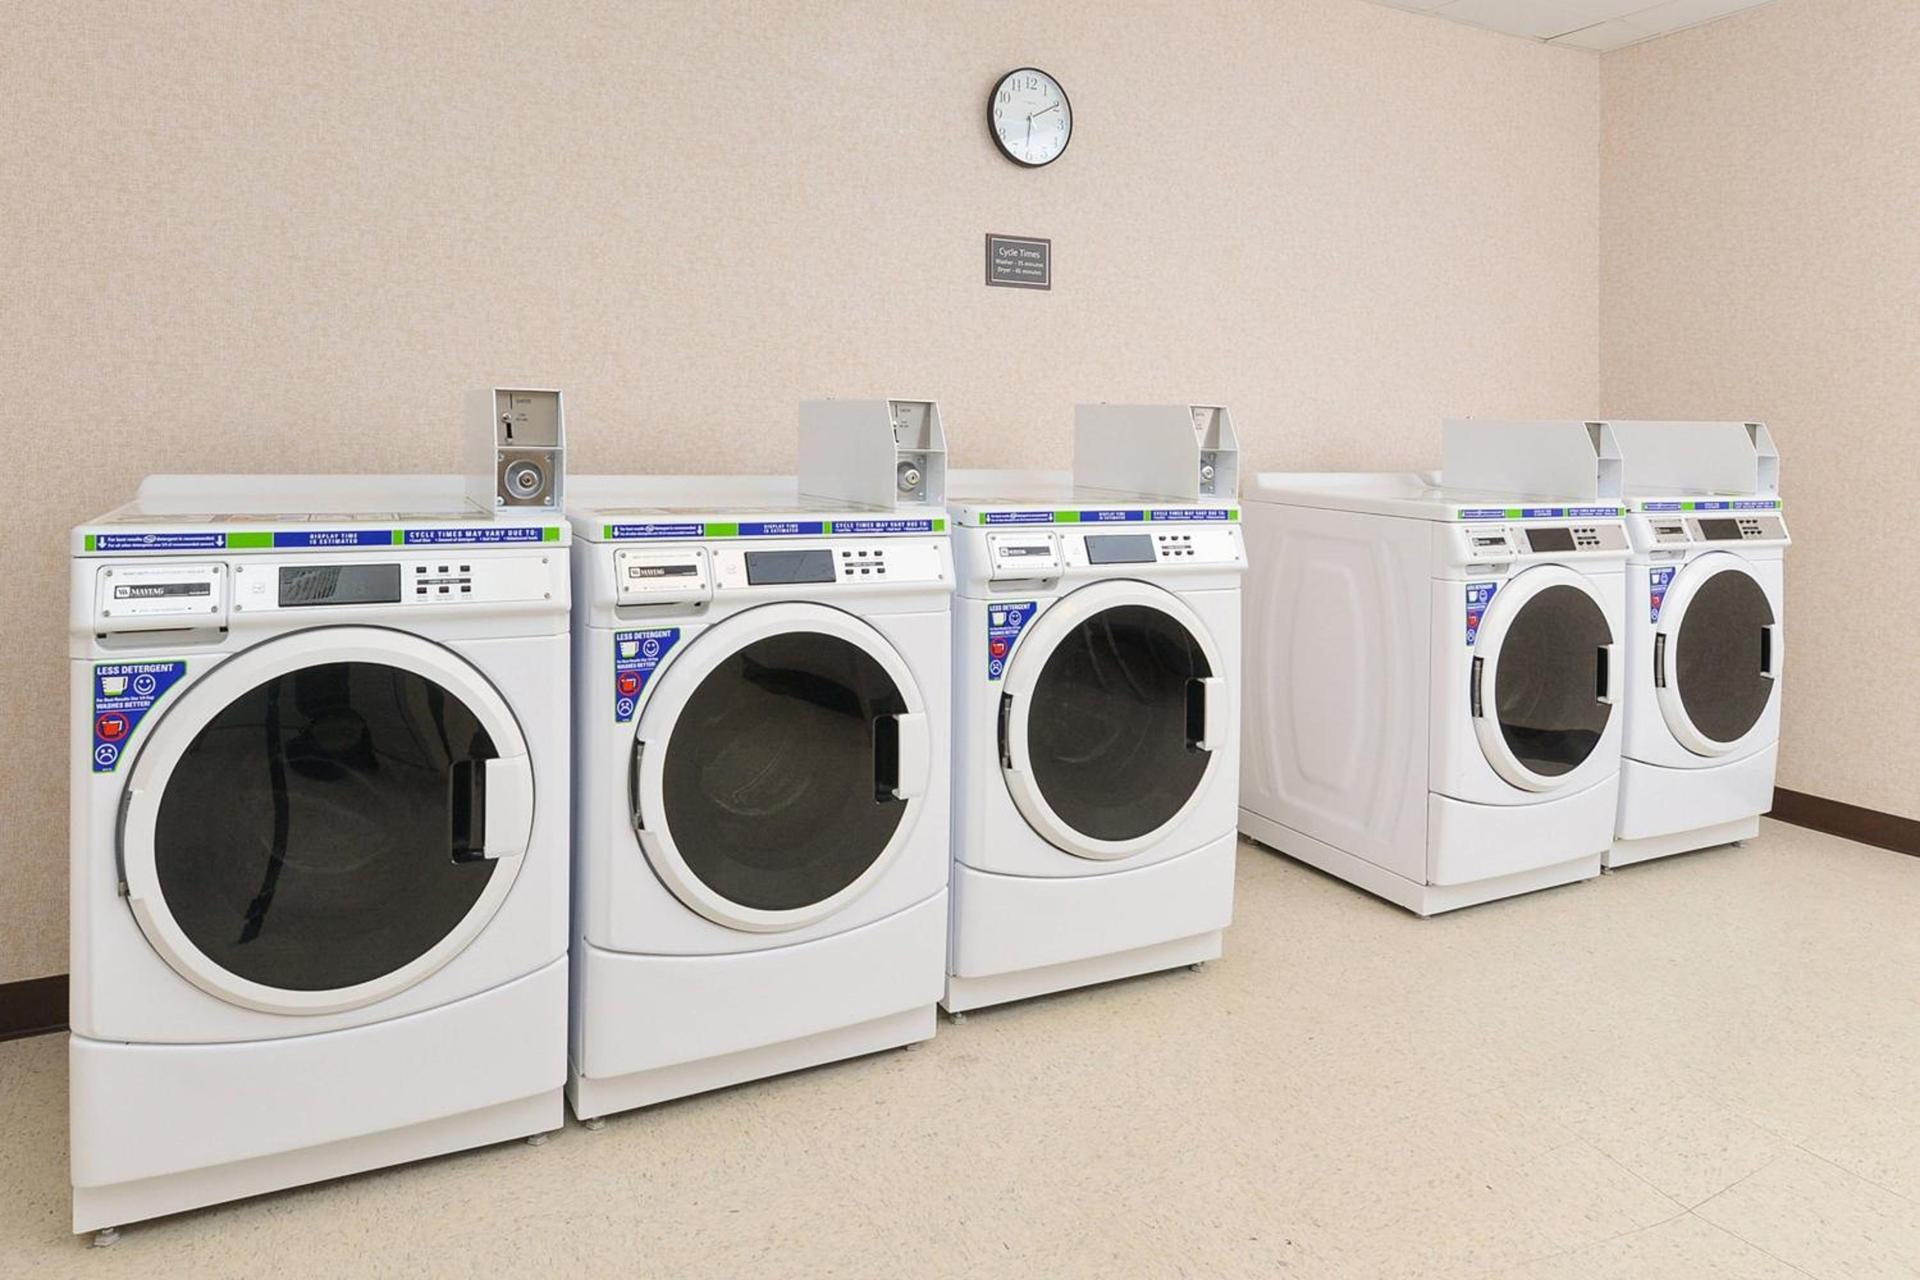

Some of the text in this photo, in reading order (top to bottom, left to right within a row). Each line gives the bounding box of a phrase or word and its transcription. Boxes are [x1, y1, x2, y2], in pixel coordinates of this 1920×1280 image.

[1012, 79, 1021, 92] 11
[1026, 77, 1038, 90] 12
[1000, 91, 1011, 104] 10
[1053, 101, 1060, 113] 2
[995, 109, 1003, 119] 9
[1057, 119, 1064, 130] 3
[999, 128, 1006, 140] 8
[999, 247, 1040, 259] Cycle Times
[130, 588, 164, 596] MAYTAG
[617, 631, 671, 641] LESS DETERGENT
[97, 664, 174, 675] LESS DETERGENT
